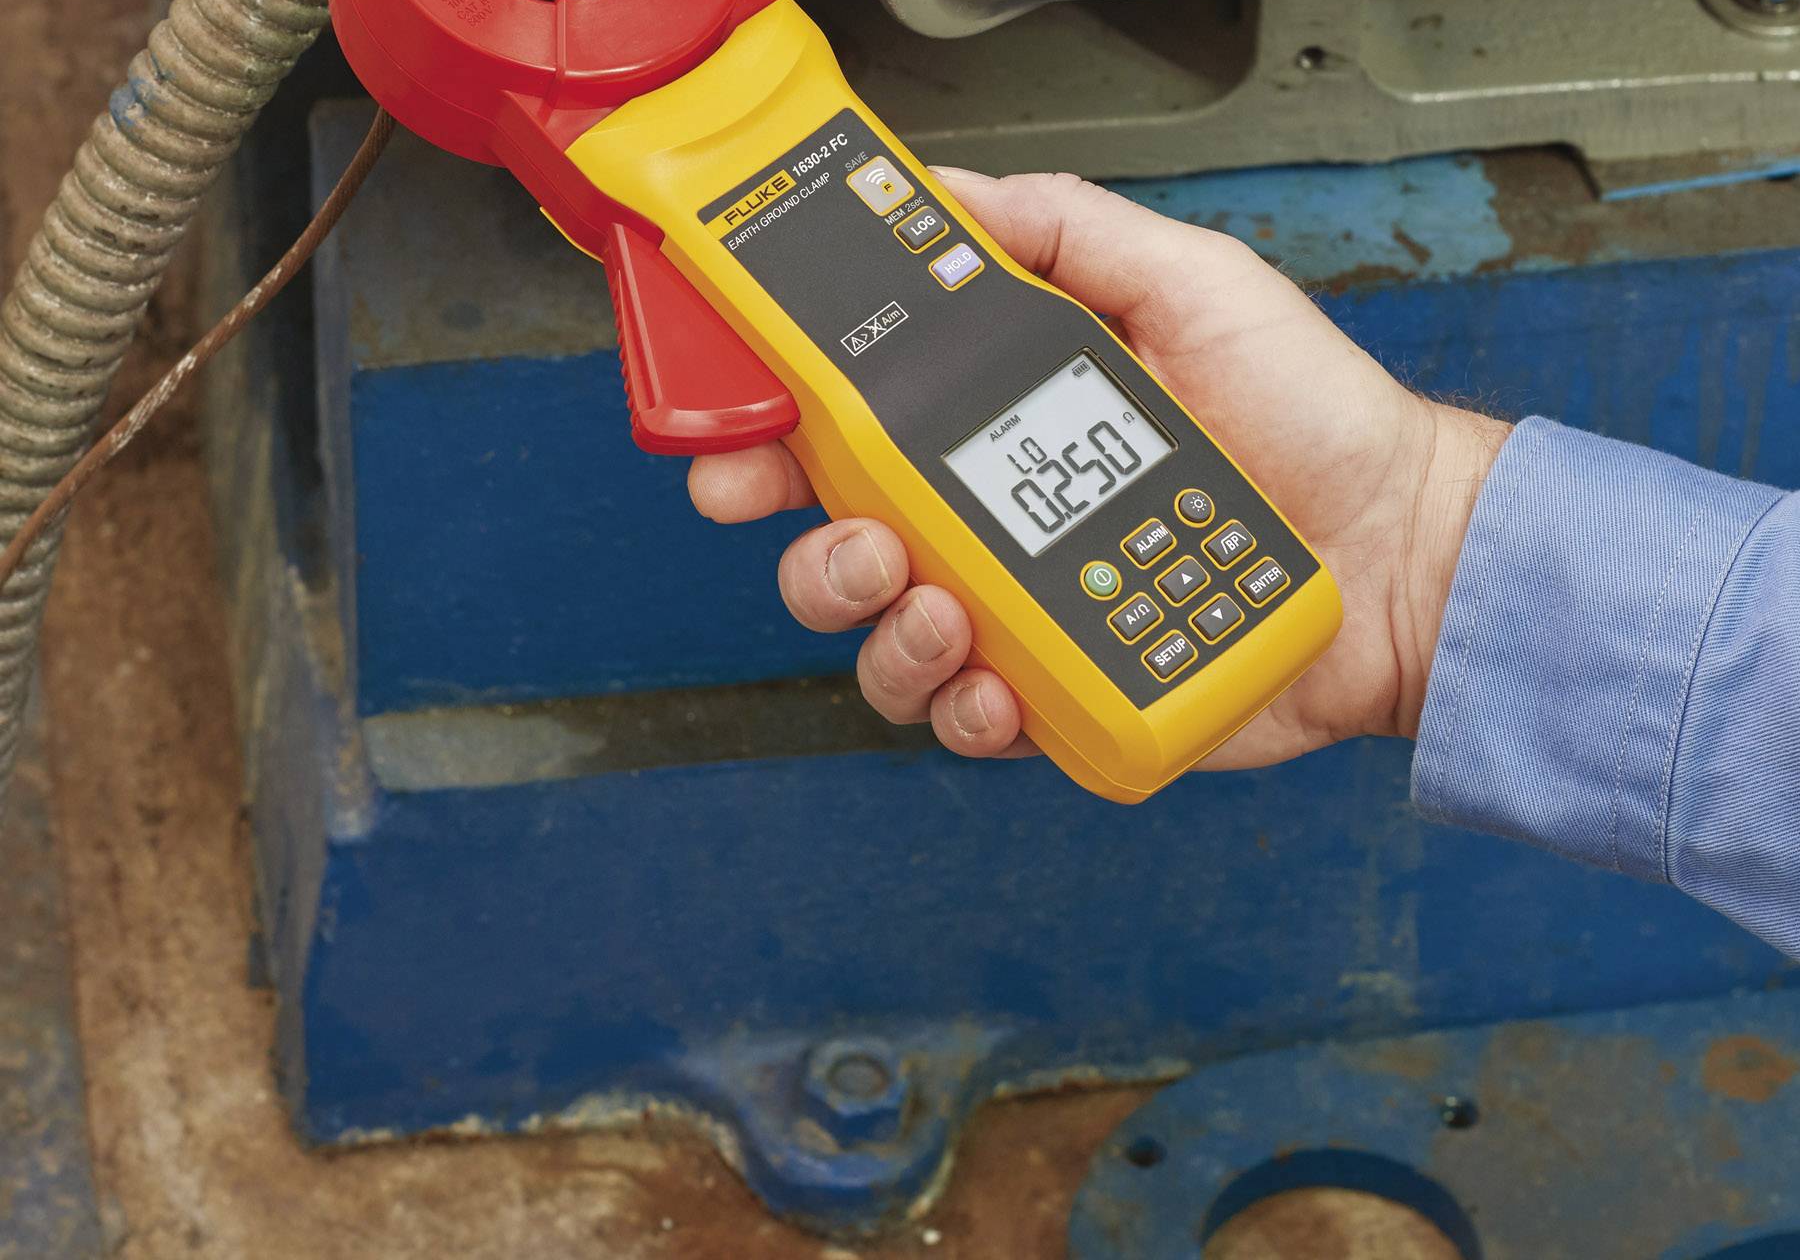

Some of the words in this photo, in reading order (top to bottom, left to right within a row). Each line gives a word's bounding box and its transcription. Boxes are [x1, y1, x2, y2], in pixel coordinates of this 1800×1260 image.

[845, 151, 869, 172] SAVE
[724, 176, 789, 225] FLUKE
[792, 145, 831, 177] 1630-2
[829, 133, 848, 152] FC
[727, 223, 761, 251] EARTH
[759, 194, 800, 227] GROUND
[800, 172, 831, 198] CLAMP
[884, 208, 906, 226] MEM
[904, 196, 925, 213] 2sec
[910, 215, 936, 236] LOG
[944, 251, 971, 274] HOLD
[881, 310, 901, 326] A/m
[989, 414, 1021, 442] ALARM
[1011, 421, 1142, 533] 0.250
[1136, 525, 1169, 554] ALARM
[1225, 535, 1241, 552] BP
[1249, 566, 1282, 594] ENTER
[1154, 638, 1187, 667] SETUP
